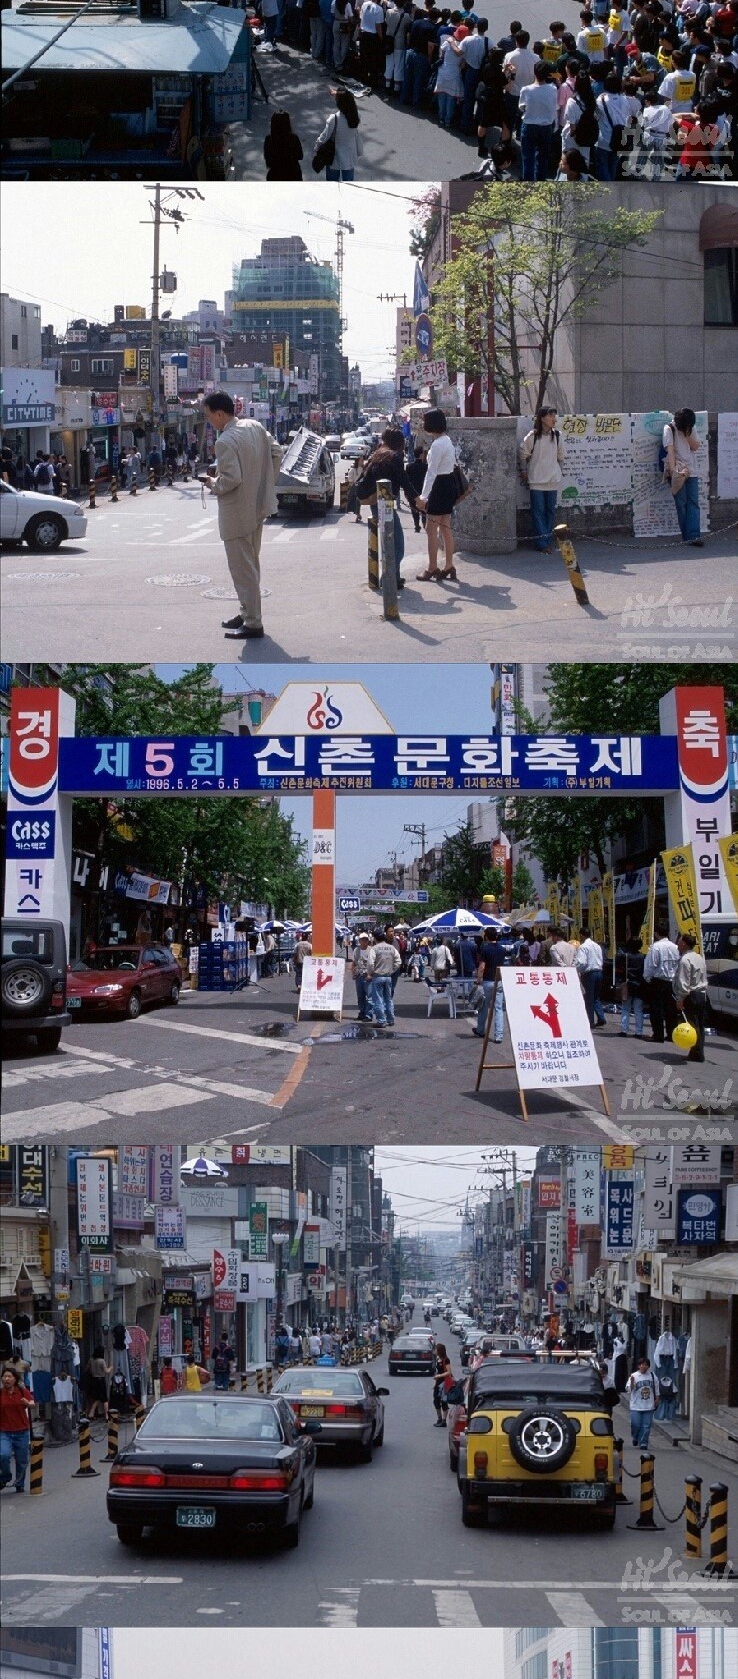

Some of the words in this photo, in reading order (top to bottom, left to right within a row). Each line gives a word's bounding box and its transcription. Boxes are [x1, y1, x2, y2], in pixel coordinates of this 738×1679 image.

[7, 406, 52, 420] CITYTIME
[16, 710, 51, 760] 경
[682, 710, 720, 759] 축
[254, 736, 642, 777] 신촌문화축제
[15, 841, 47, 851] 카스맥주
[17, 868, 43, 914] 카스
[515, 971, 568, 986] 교통통제
